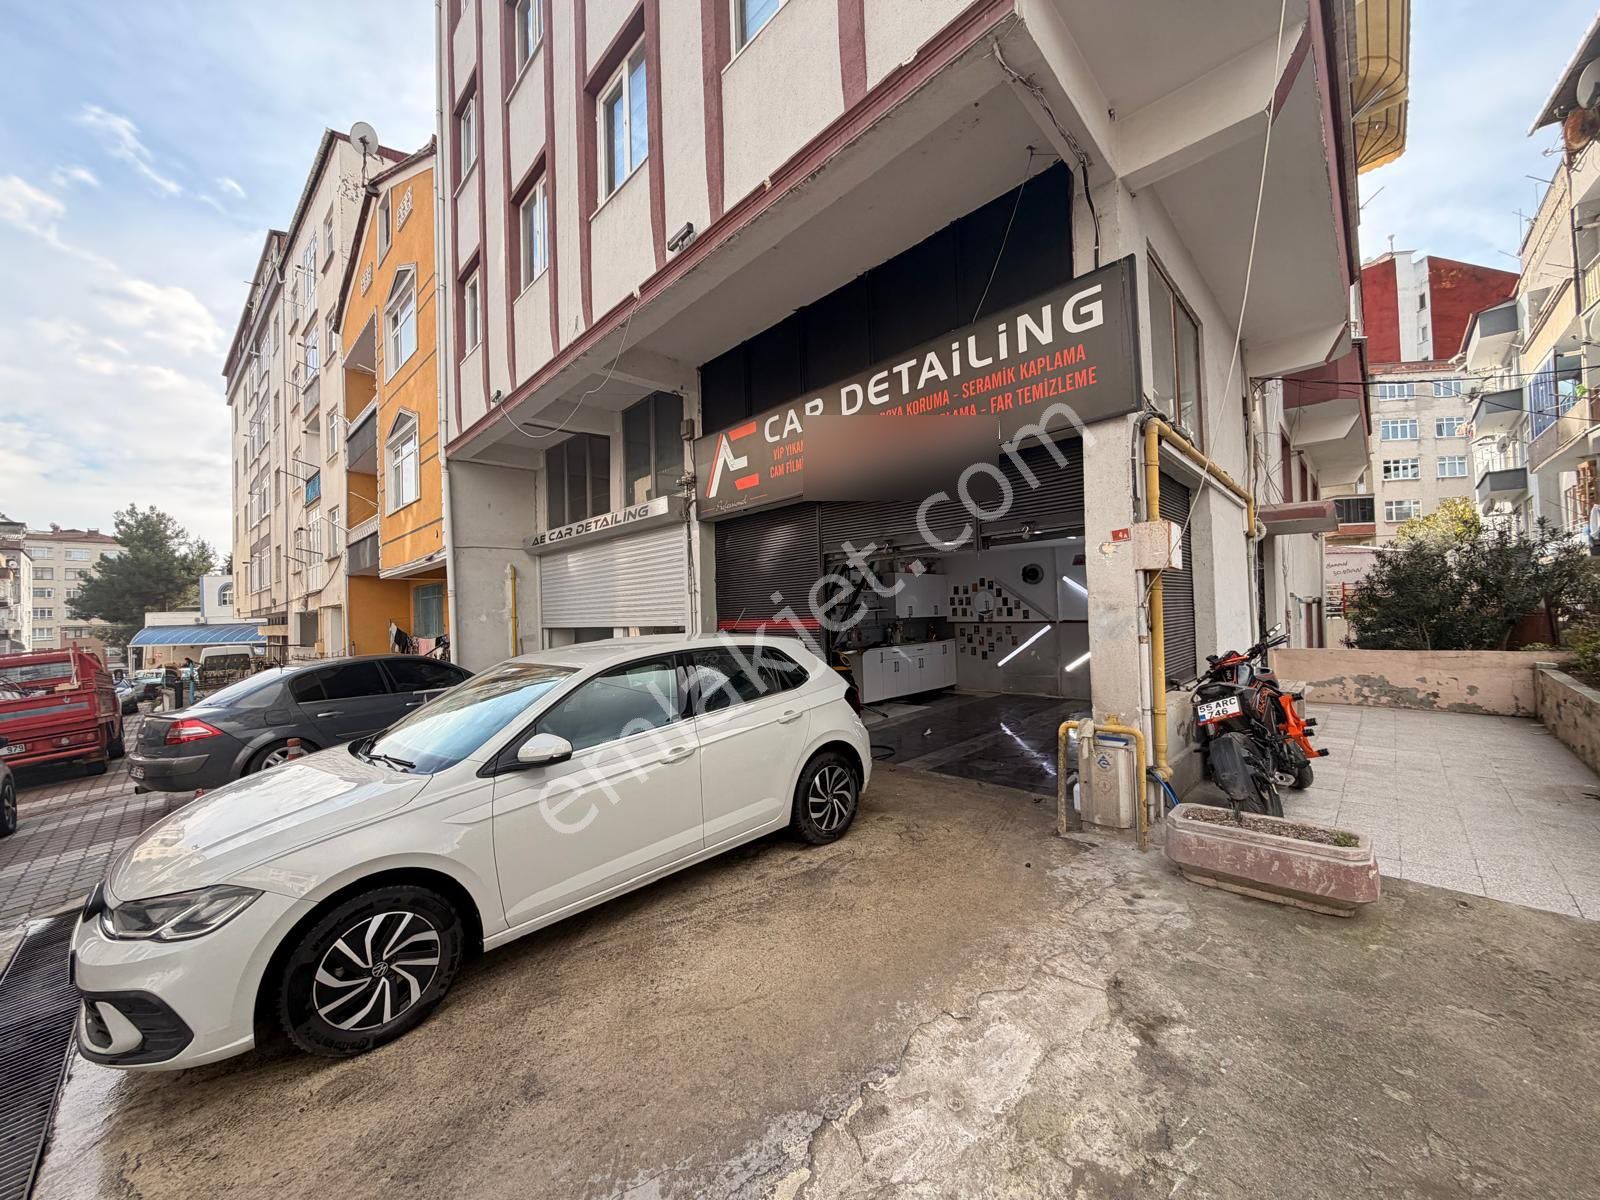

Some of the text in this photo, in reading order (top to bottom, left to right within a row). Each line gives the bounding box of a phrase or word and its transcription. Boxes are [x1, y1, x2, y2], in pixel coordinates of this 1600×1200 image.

[906, 389, 950, 416] KORUMA
[962, 366, 1016, 398] SERAMİK
[1020, 343, 1087, 380] KAPLAMA
[769, 463, 785, 479] CAM
[990, 392, 1013, 414] FAR
[1016, 366, 1097, 406] TEMİZLEME
[548, 527, 573, 541] CAR
[1199, 697, 1237, 713] 55 ARC
[1207, 707, 1229, 719] 746
[6, 744, 24, 754] 979
